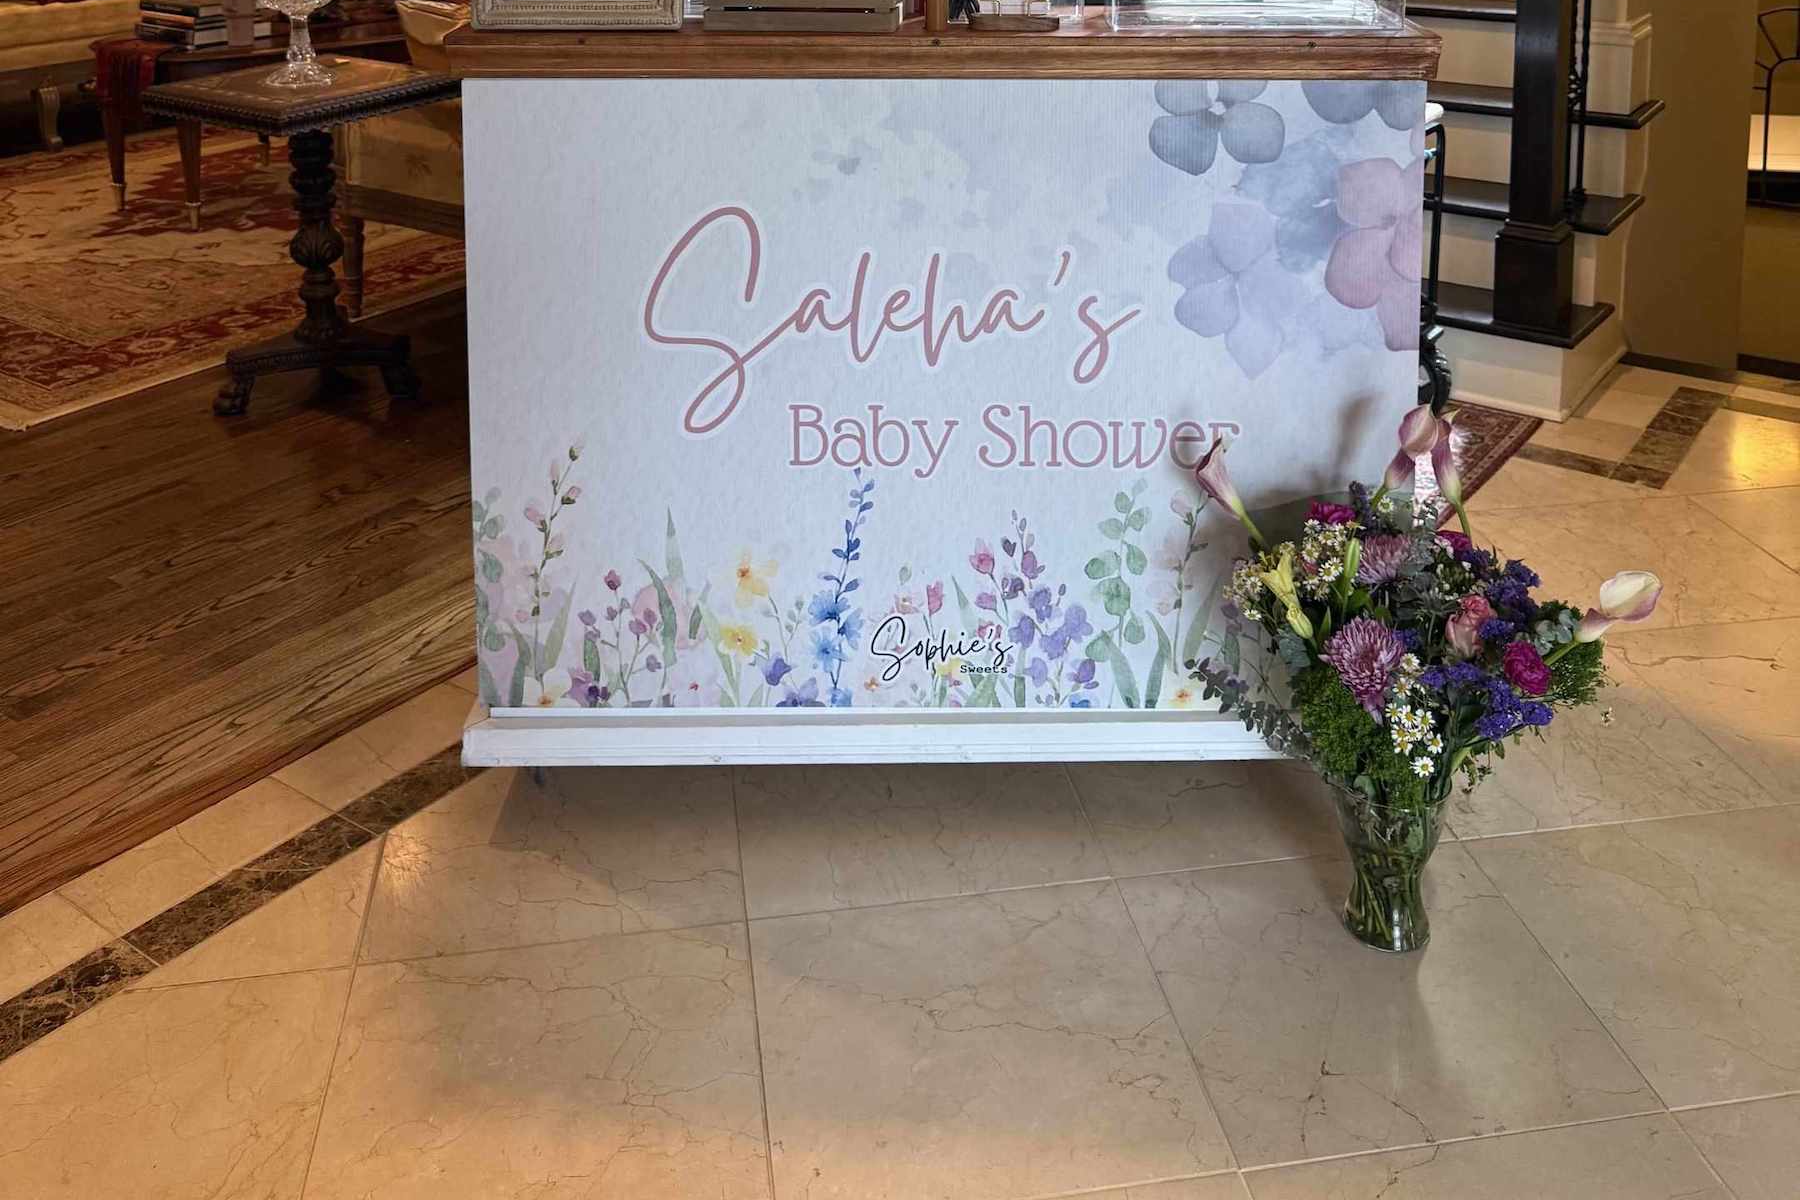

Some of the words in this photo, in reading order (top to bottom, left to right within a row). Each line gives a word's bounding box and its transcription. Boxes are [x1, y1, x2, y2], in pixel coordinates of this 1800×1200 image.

[644, 205, 1141, 434] Saleha's
[788, 404, 959, 479] Baby
[977, 404, 1240, 470] Shower
[871, 616, 1014, 681] Sophie's
[959, 664, 1008, 674] Sweets
